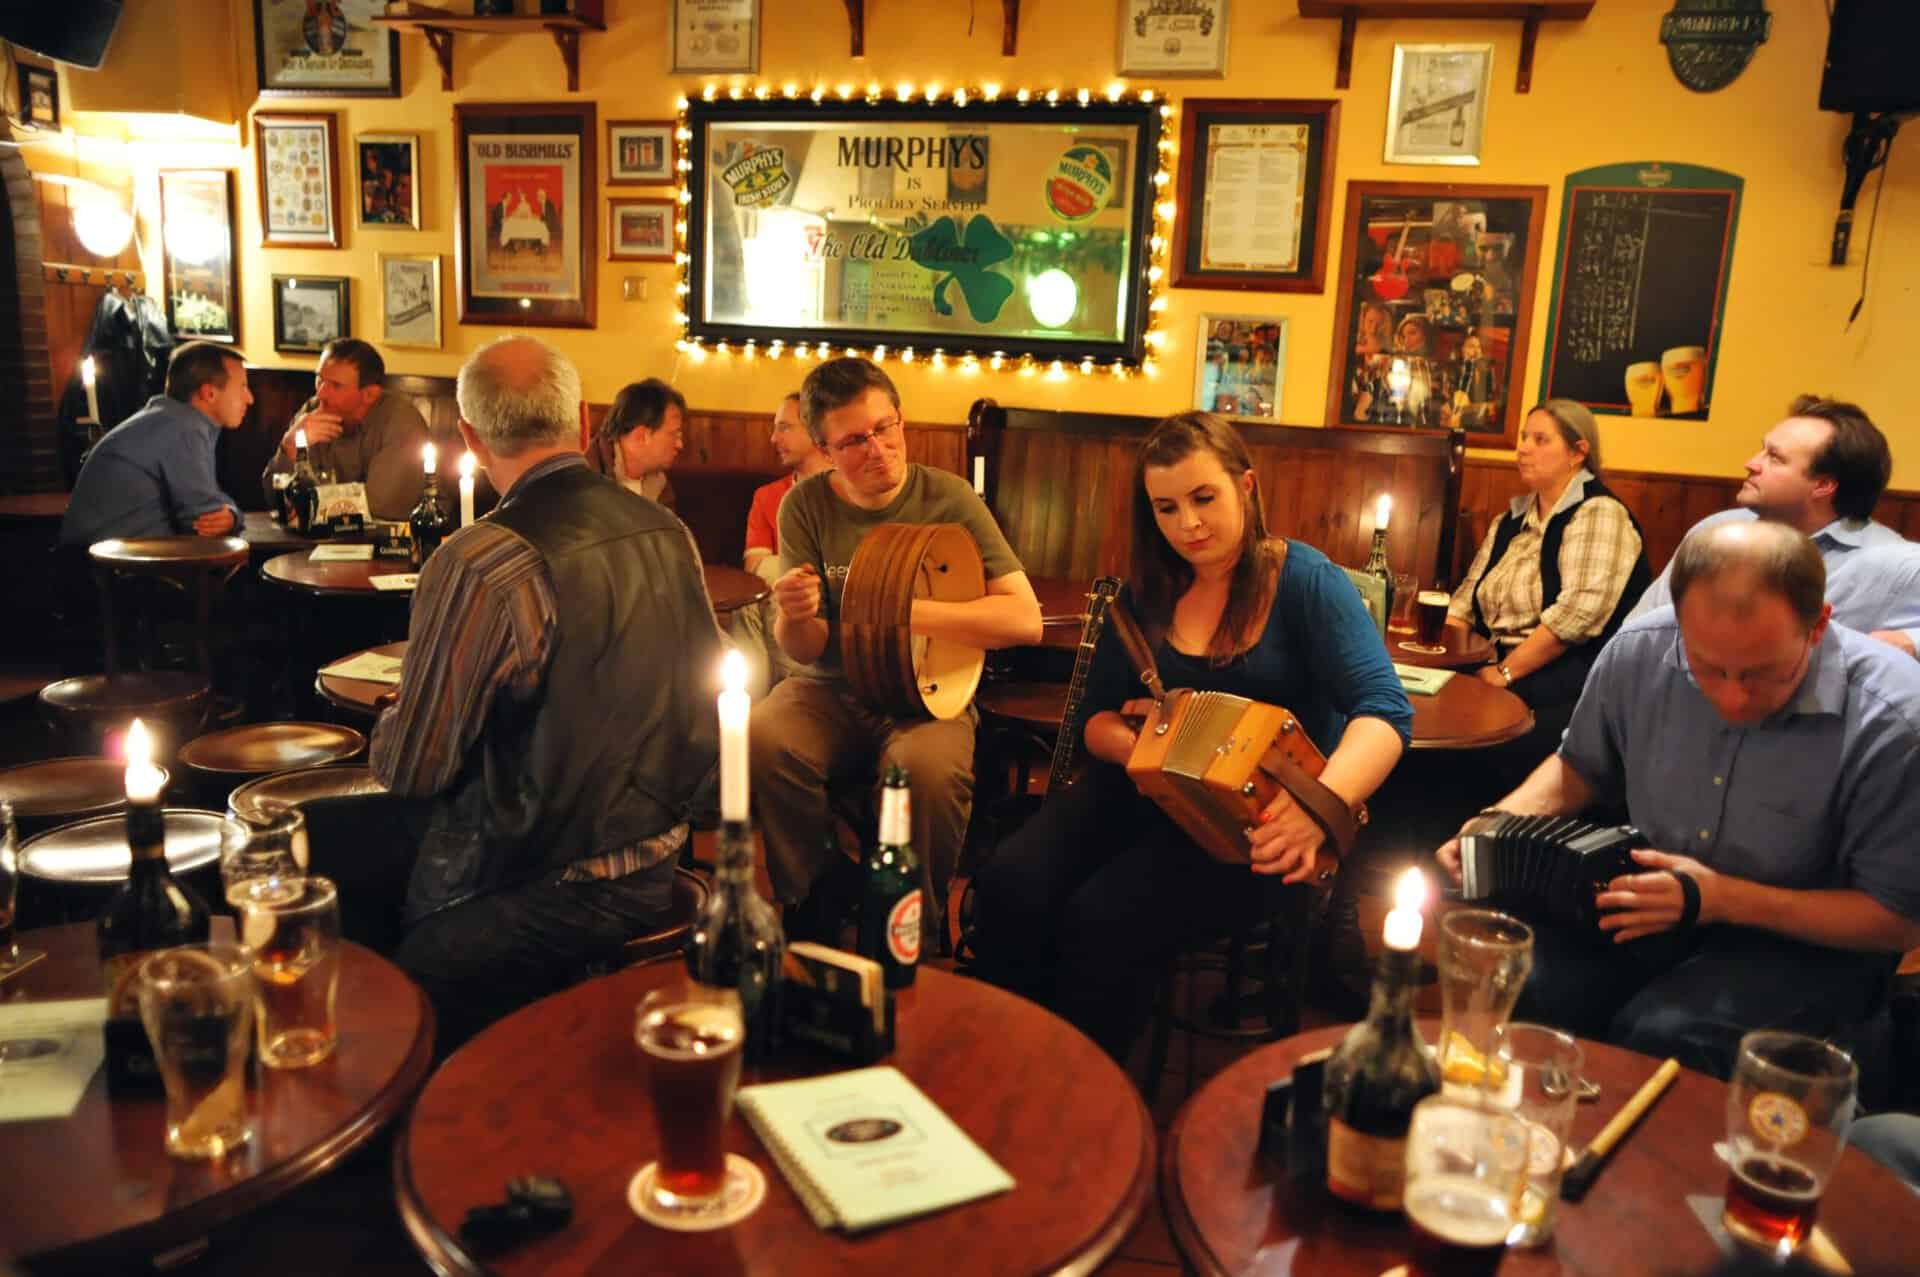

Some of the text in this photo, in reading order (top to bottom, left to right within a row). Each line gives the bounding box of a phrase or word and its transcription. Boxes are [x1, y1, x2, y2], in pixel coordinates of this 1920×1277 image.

[837, 135, 986, 172] MURPHY'S
[906, 176, 922, 191] IS
[850, 232, 888, 260] Old
